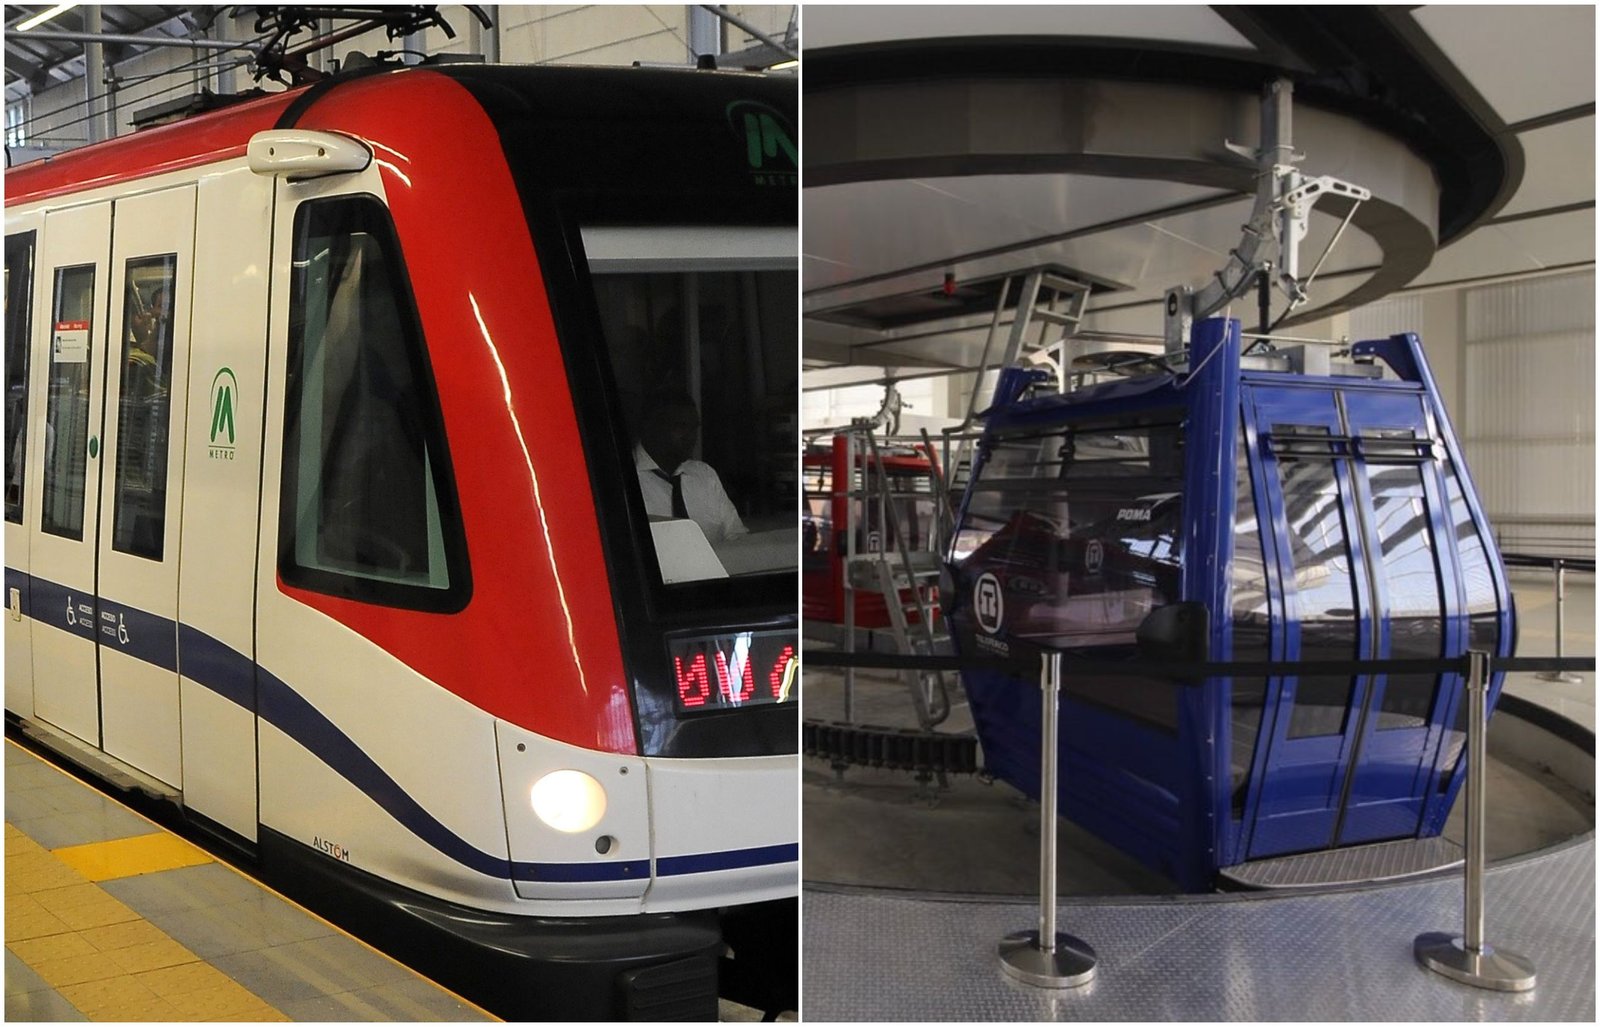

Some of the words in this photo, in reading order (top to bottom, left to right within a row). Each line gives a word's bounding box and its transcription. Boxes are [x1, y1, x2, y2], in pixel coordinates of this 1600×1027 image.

[209, 450, 234, 460] METRO
[1117, 508, 1151, 521] POMA
[313, 836, 349, 861] ALSTOM
